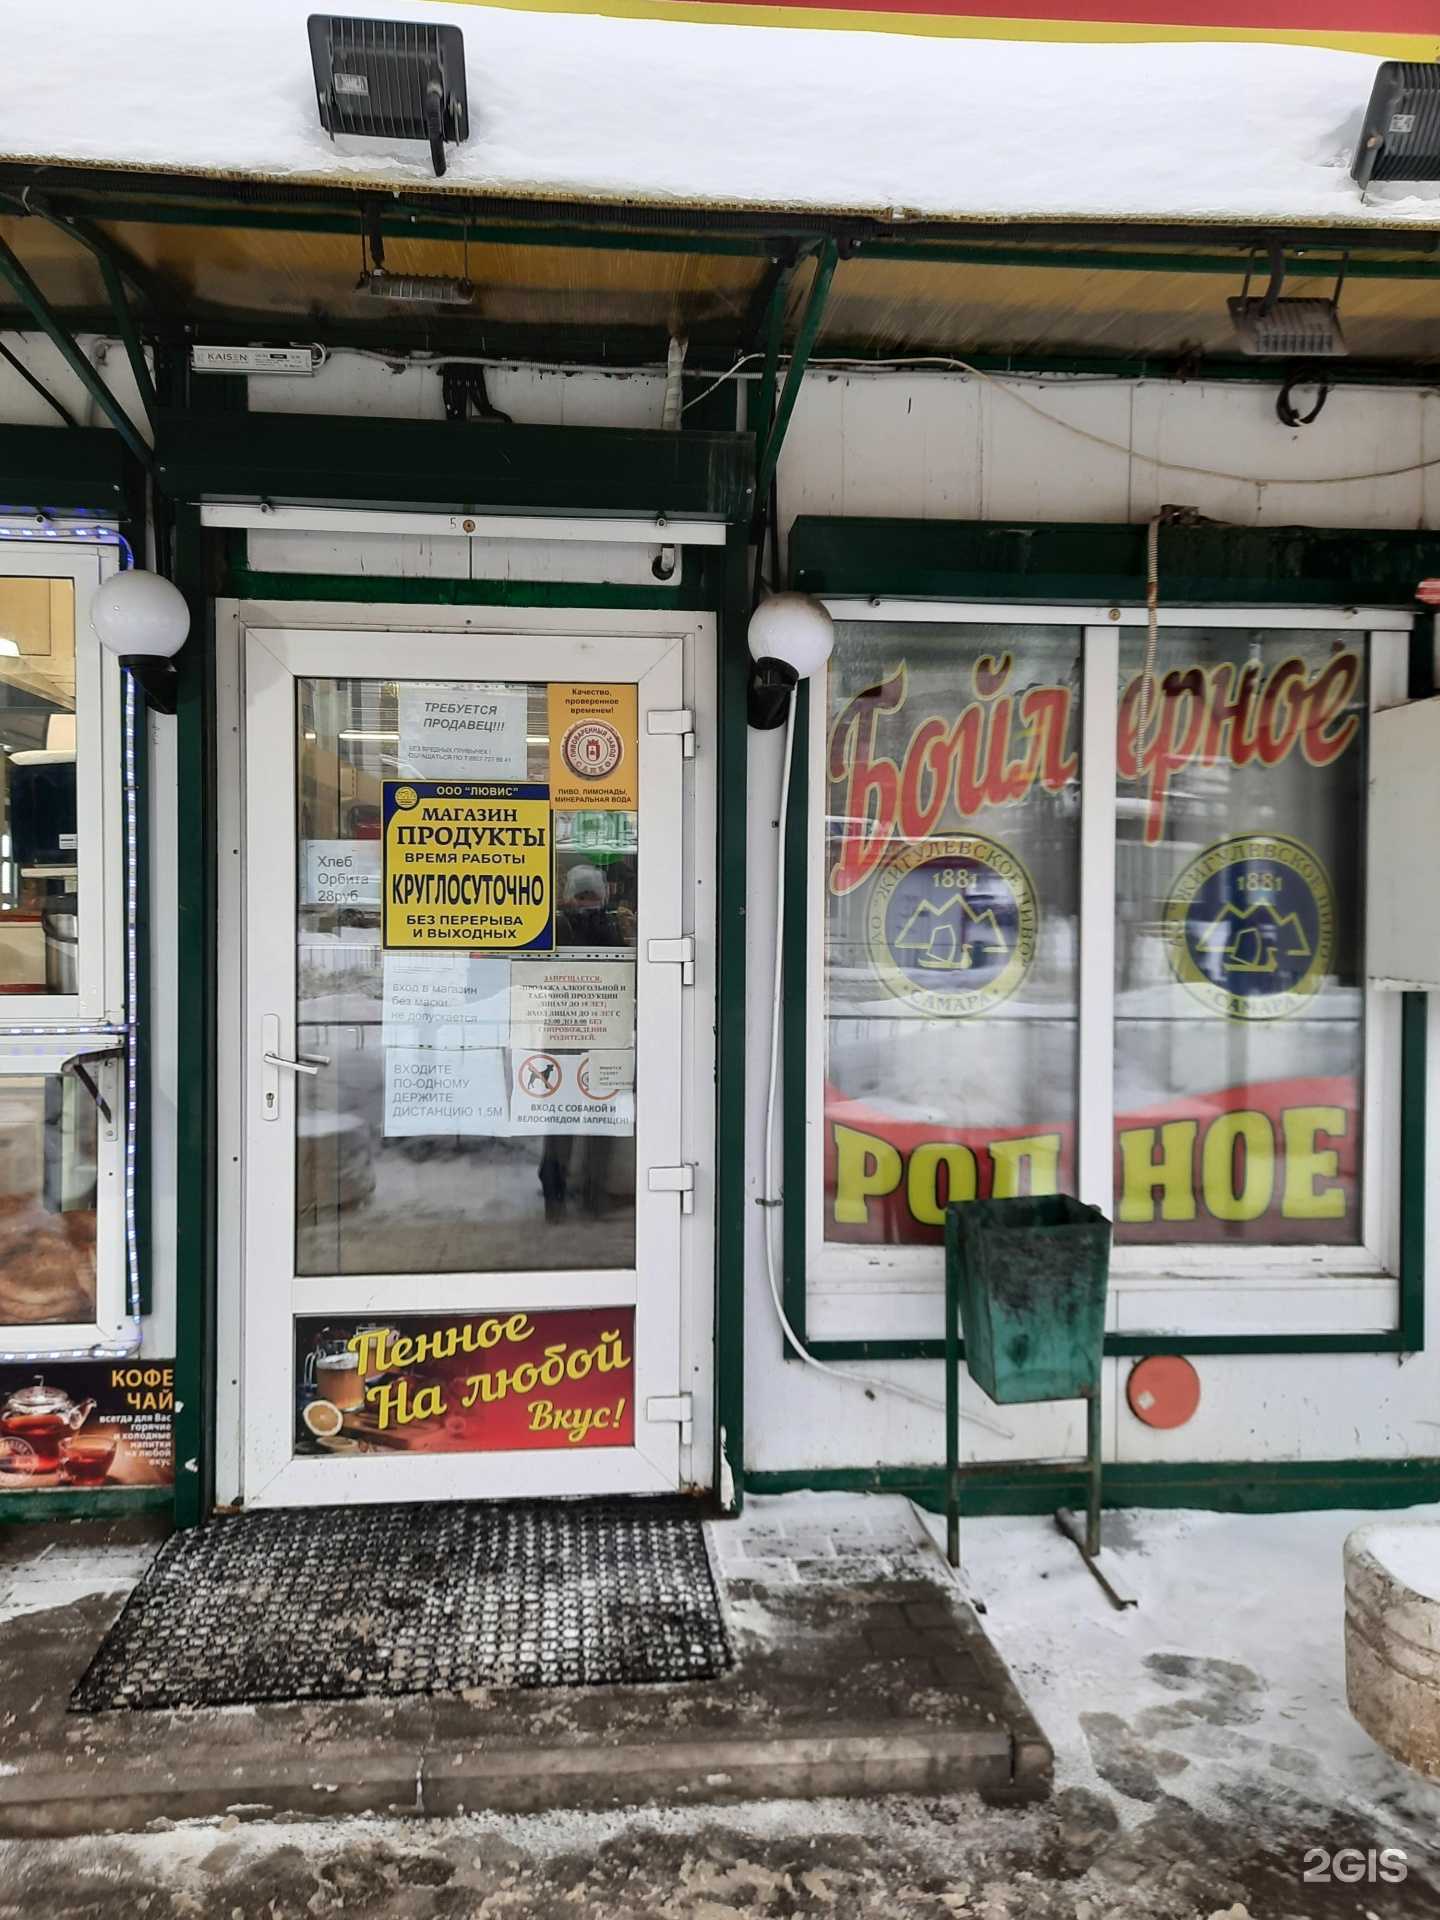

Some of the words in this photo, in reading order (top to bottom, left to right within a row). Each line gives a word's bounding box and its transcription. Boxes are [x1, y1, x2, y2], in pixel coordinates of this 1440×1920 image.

[572, 688, 612, 697] Качество,
[565, 698, 619, 706] проверенное
[424, 702, 498, 716] ТРЕБУЕТСЯ
[570, 706, 614, 715] временем!
[423, 718, 505, 733] ПРОДАВЕЦ!!!
[436, 786, 463, 796] ООО
[464, 786, 519, 797] "ЛЮВИС"
[555, 796, 610, 804] МИНЕРАЛЬНАЯ
[611, 796, 632, 804] ВОДА
[422, 807, 518, 822] МАГАЗИН
[397, 826, 545, 849] ПРОДУКТЫ
[318, 856, 353, 867] Хлеб
[405, 853, 457, 863] ВРЕМЯ
[462, 853, 525, 864] РАБОТЫ
[318, 873, 369, 887] Орбита
[932, 868, 978, 888] 1881
[1236, 872, 1283, 892] 1881
[392, 874, 544, 905] КРУГЛОСУТОЧНО
[318, 890, 360, 903] 28руб
[406, 915, 436, 925] БЕЗ
[440, 915, 524, 926] ПЕРЕРЫВА
[413, 929, 423, 938] И
[427, 929, 517, 940] ВЫХОДНЫХ
[392, 984, 419, 994] Вход
[432, 985, 478, 996] магазин
[563, 983, 619, 992] АЛКОГОЛЬНОЙ
[392, 996, 412, 1007] без
[571, 992, 618, 1000] ПРОДУКЦИИ
[909, 988, 990, 1013] САМАРА
[408, 1012, 478, 1024] допускается
[394, 1064, 452, 1075] ВХОДИТЕ
[393, 1078, 470, 1090] ПО-ОДНОМУ
[392, 1092, 453, 1103] ДЕРЖИТЕ
[392, 1106, 473, 1118] ДИСТАНЦИЮ
[531, 1104, 555, 1113] ВХОД
[557, 1104, 564, 1113] С
[565, 1103, 608, 1113] СОБАКОЙ
[610, 1105, 617, 1113] И
[517, 1115, 581, 1124] ВЕЛОСИПЕДОМ
[348, 1313, 535, 1377] Пенное
[111, 1369, 174, 1388] КОФЕ
[366, 1376, 448, 1430] На
[461, 1328, 632, 1408] любой
[127, 1389, 174, 1410] ЧАЙ
[99, 1414, 133, 1424] всегда
[134, 1414, 153, 1424] для
[154, 1413, 172, 1423] Вас
[528, 1398, 626, 1443] Вкус!
[130, 1423, 172, 1432] горячие
[122, 1432, 172, 1441] холодные
[129, 1441, 172, 1449] напитки
[148, 1458, 171, 1468] вкус
